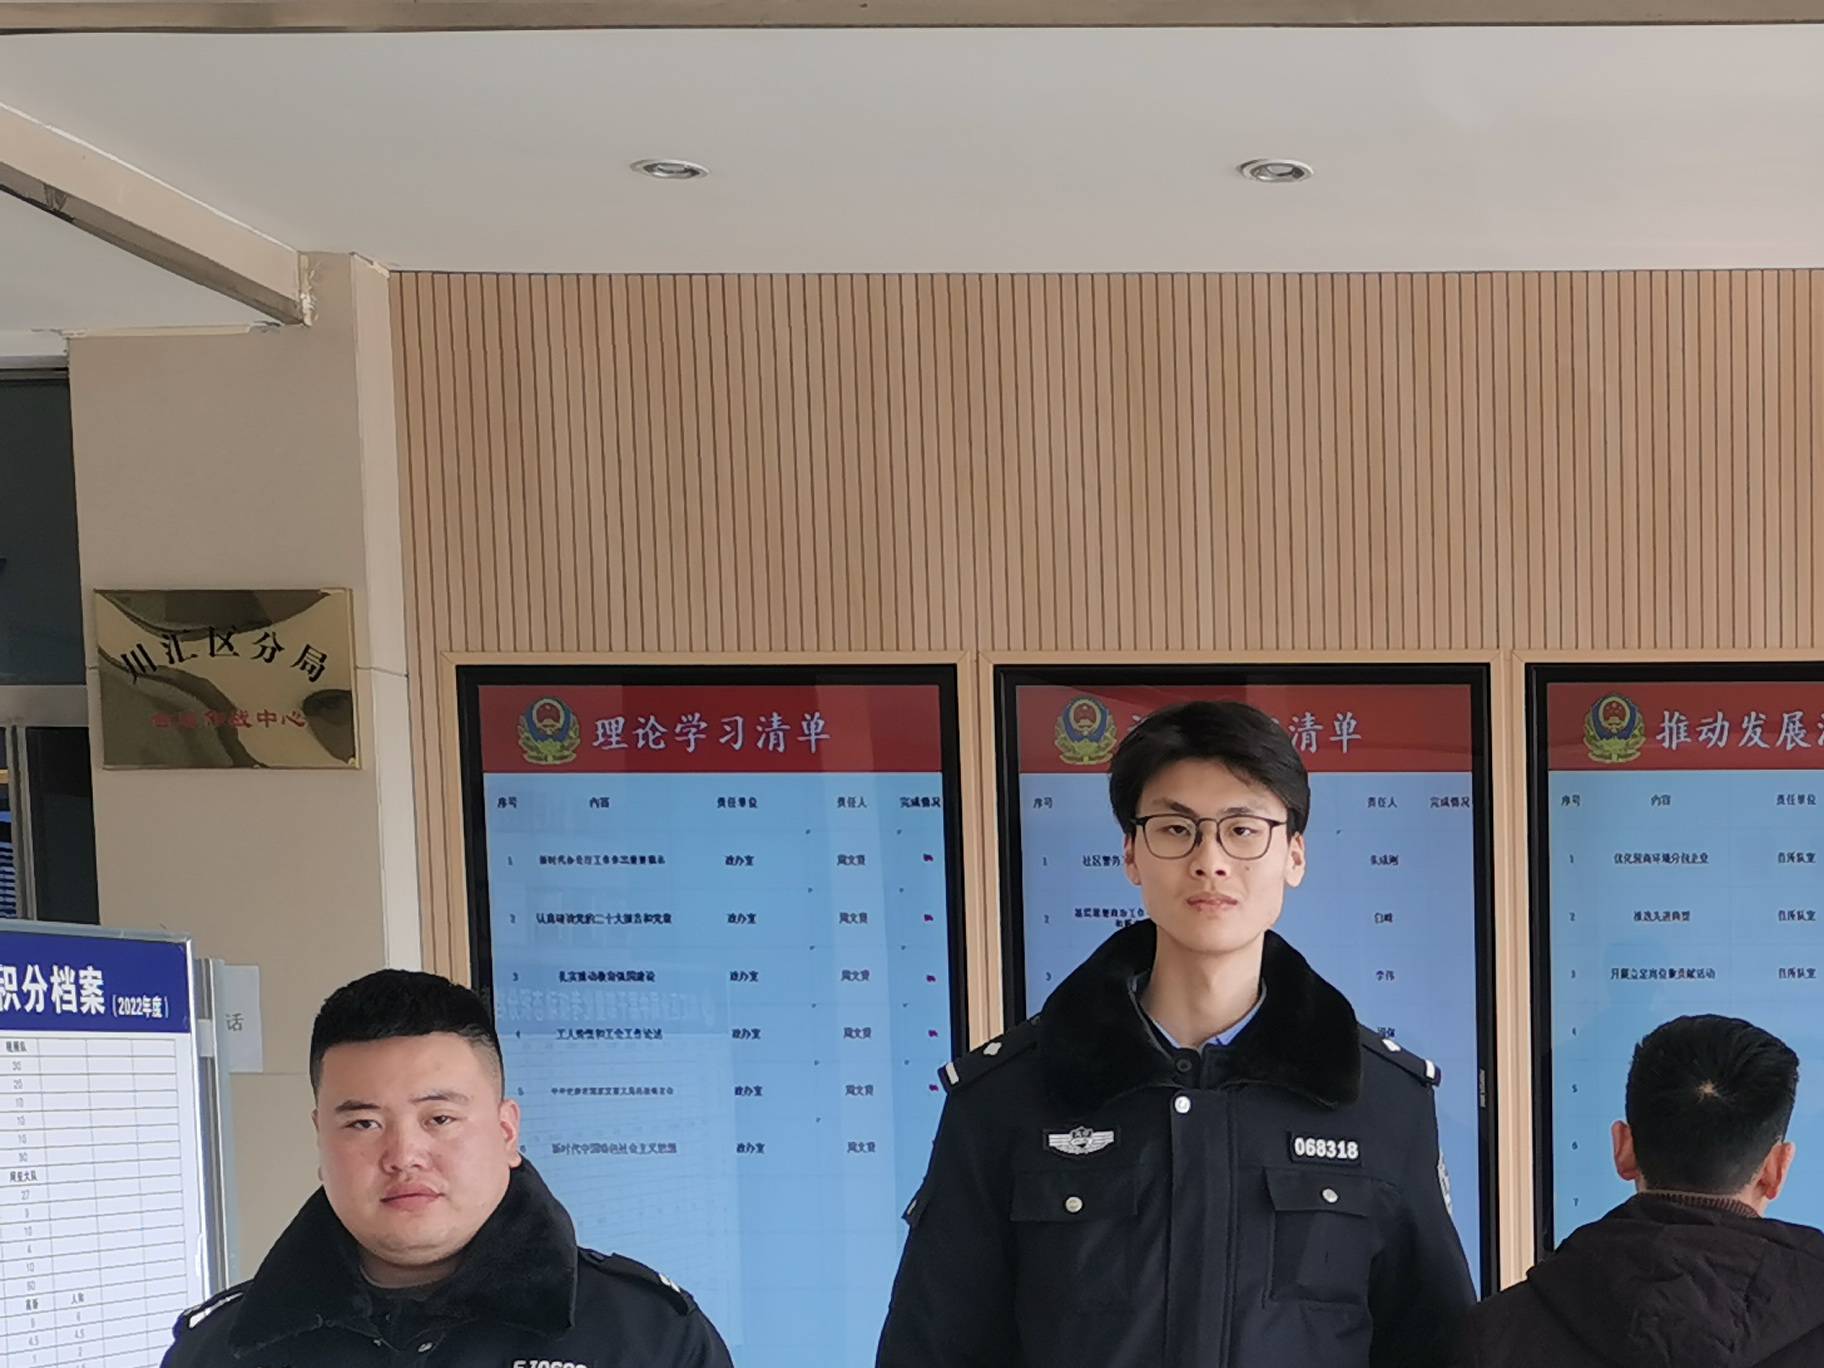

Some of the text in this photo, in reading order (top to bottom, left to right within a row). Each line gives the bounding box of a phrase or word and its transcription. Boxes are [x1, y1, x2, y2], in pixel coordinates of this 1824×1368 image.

[121, 626, 327, 684] 川汇区分局
[592, 711, 832, 754] 理论学习清单
[1294, 1136, 1360, 1160] 068318
